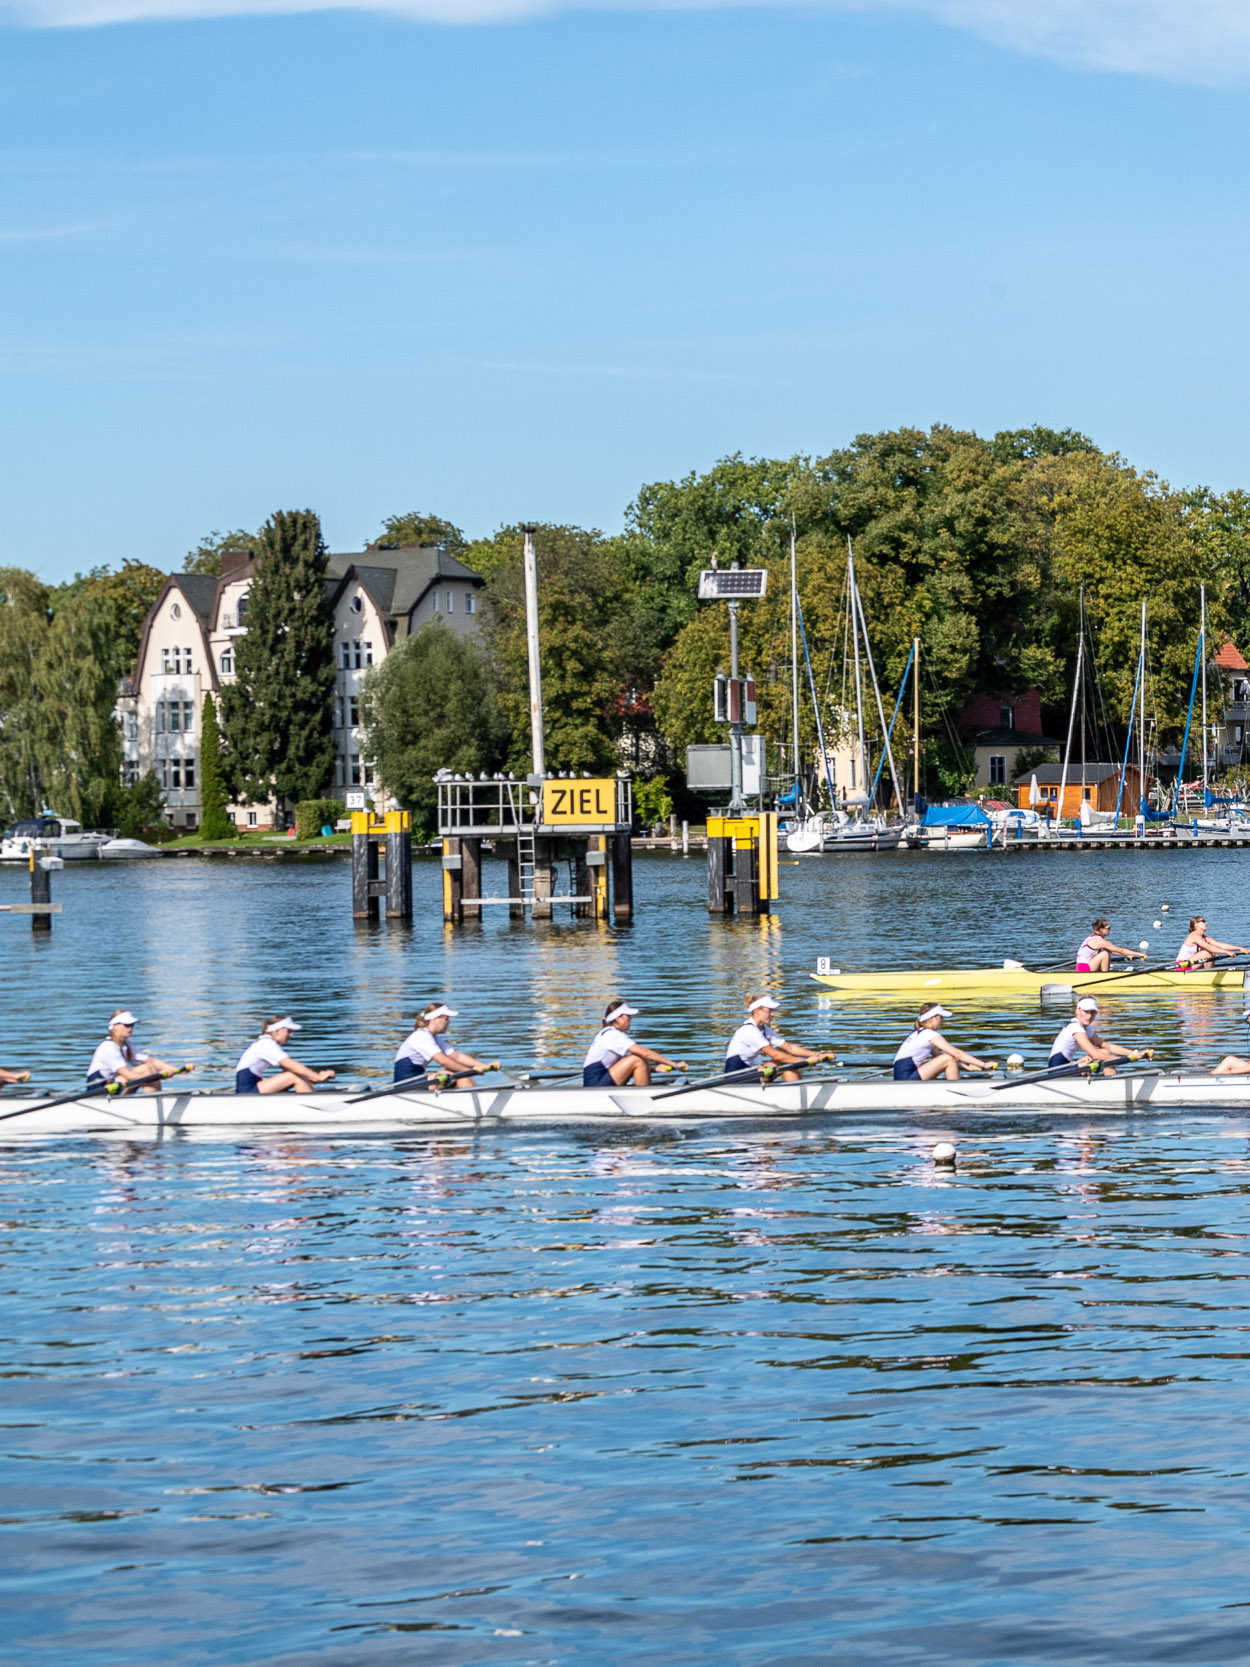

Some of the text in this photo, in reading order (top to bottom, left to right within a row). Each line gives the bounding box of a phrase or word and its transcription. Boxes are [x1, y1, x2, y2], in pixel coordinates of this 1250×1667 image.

[350, 795, 361, 805] 37
[551, 789, 607, 815] ZIEL
[820, 958, 826, 970] 8
